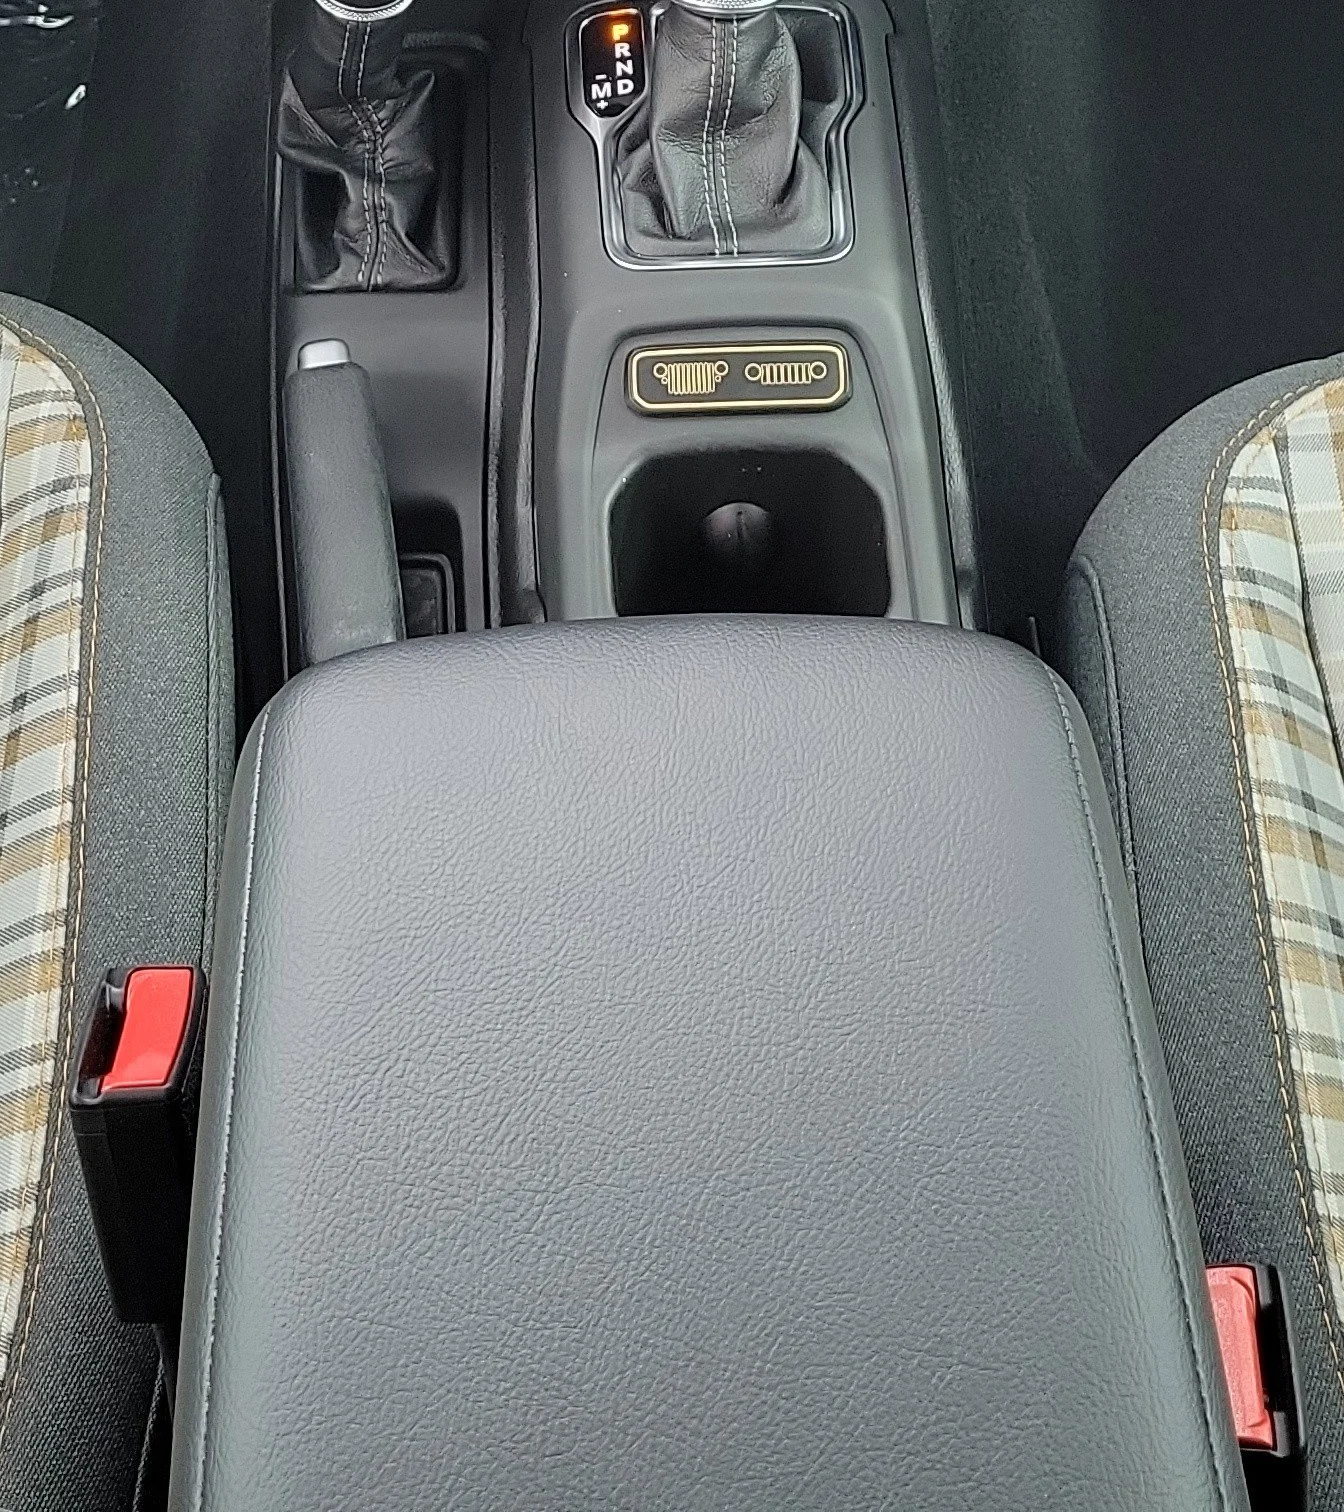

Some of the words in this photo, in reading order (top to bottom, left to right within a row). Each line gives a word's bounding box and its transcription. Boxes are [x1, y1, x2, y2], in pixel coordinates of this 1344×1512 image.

[611, 23, 630, 41] P
[614, 42, 632, 59] R
[615, 59, 634, 77] N
[590, 81, 613, 100] M
[616, 78, 635, 96] D
